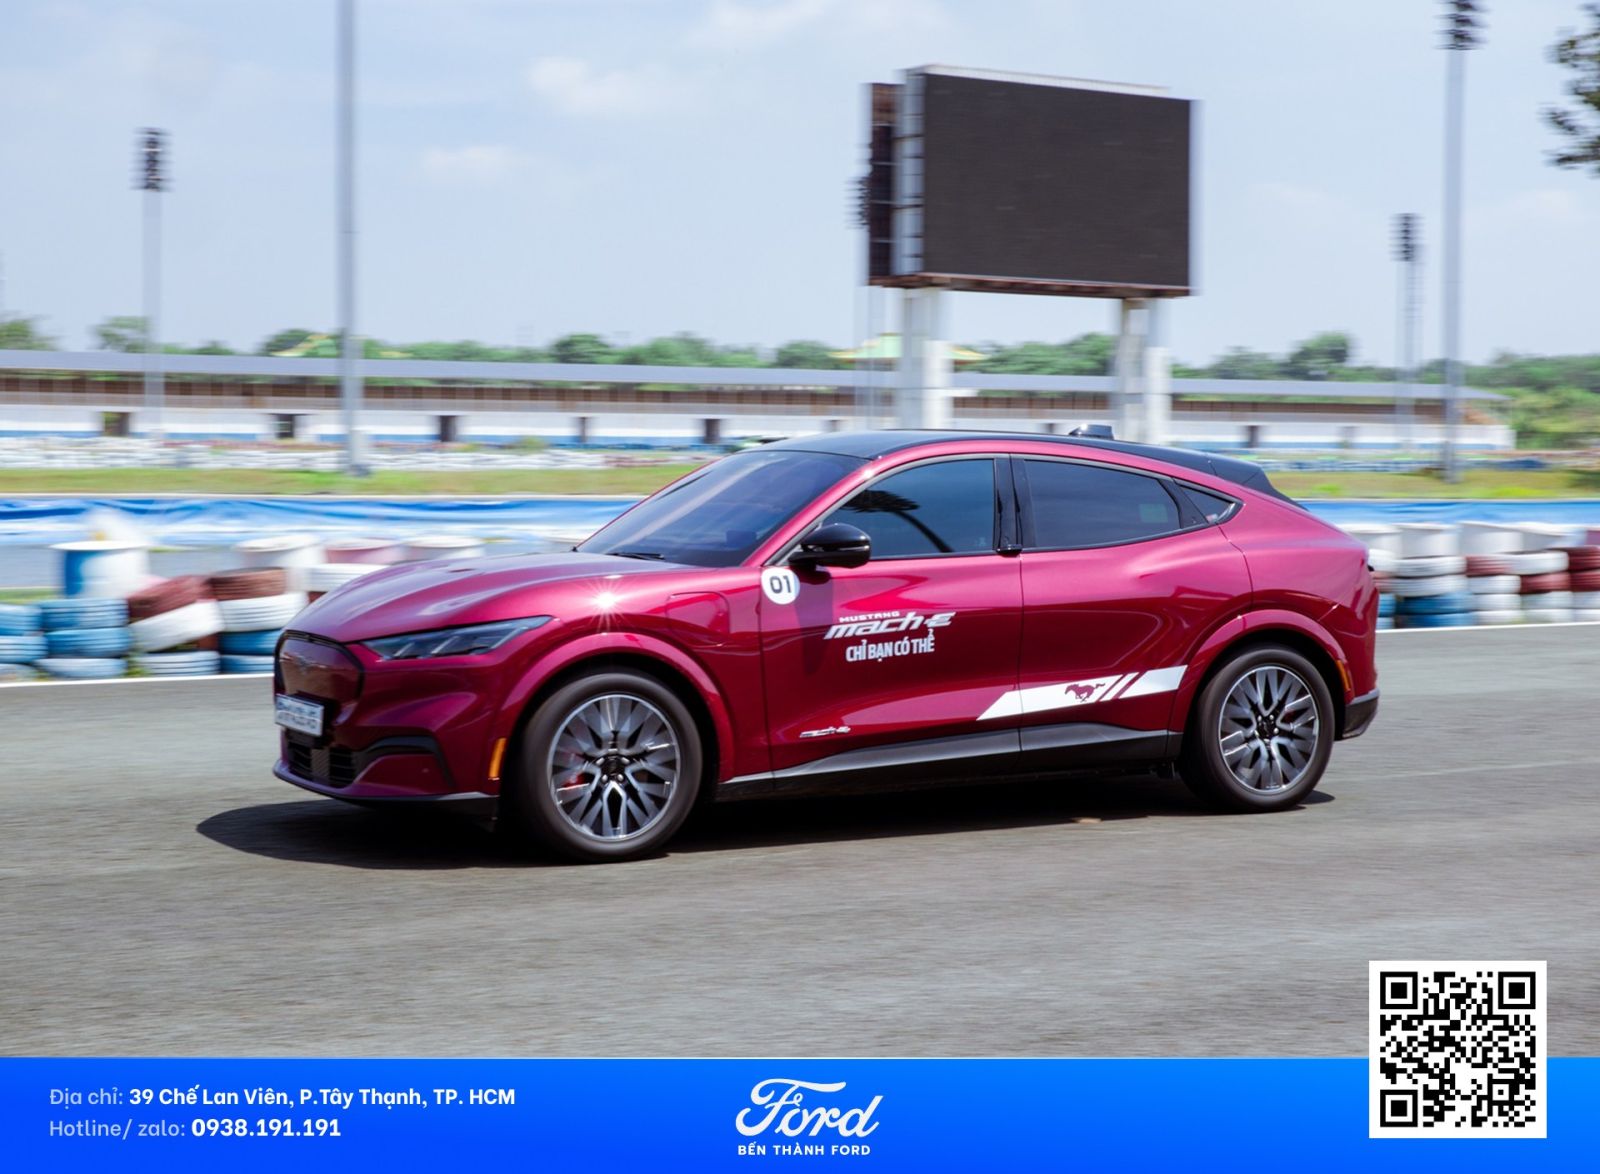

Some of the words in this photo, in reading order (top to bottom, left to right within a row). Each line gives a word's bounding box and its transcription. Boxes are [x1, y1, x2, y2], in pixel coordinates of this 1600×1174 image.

[770, 575, 792, 594] 01
[839, 611, 900, 623] MUSTANG
[845, 638, 867, 662] CHỈ
[868, 641, 893, 662] BẠN
[894, 636, 910, 656] CÓ
[911, 628, 936, 654] THỂ
